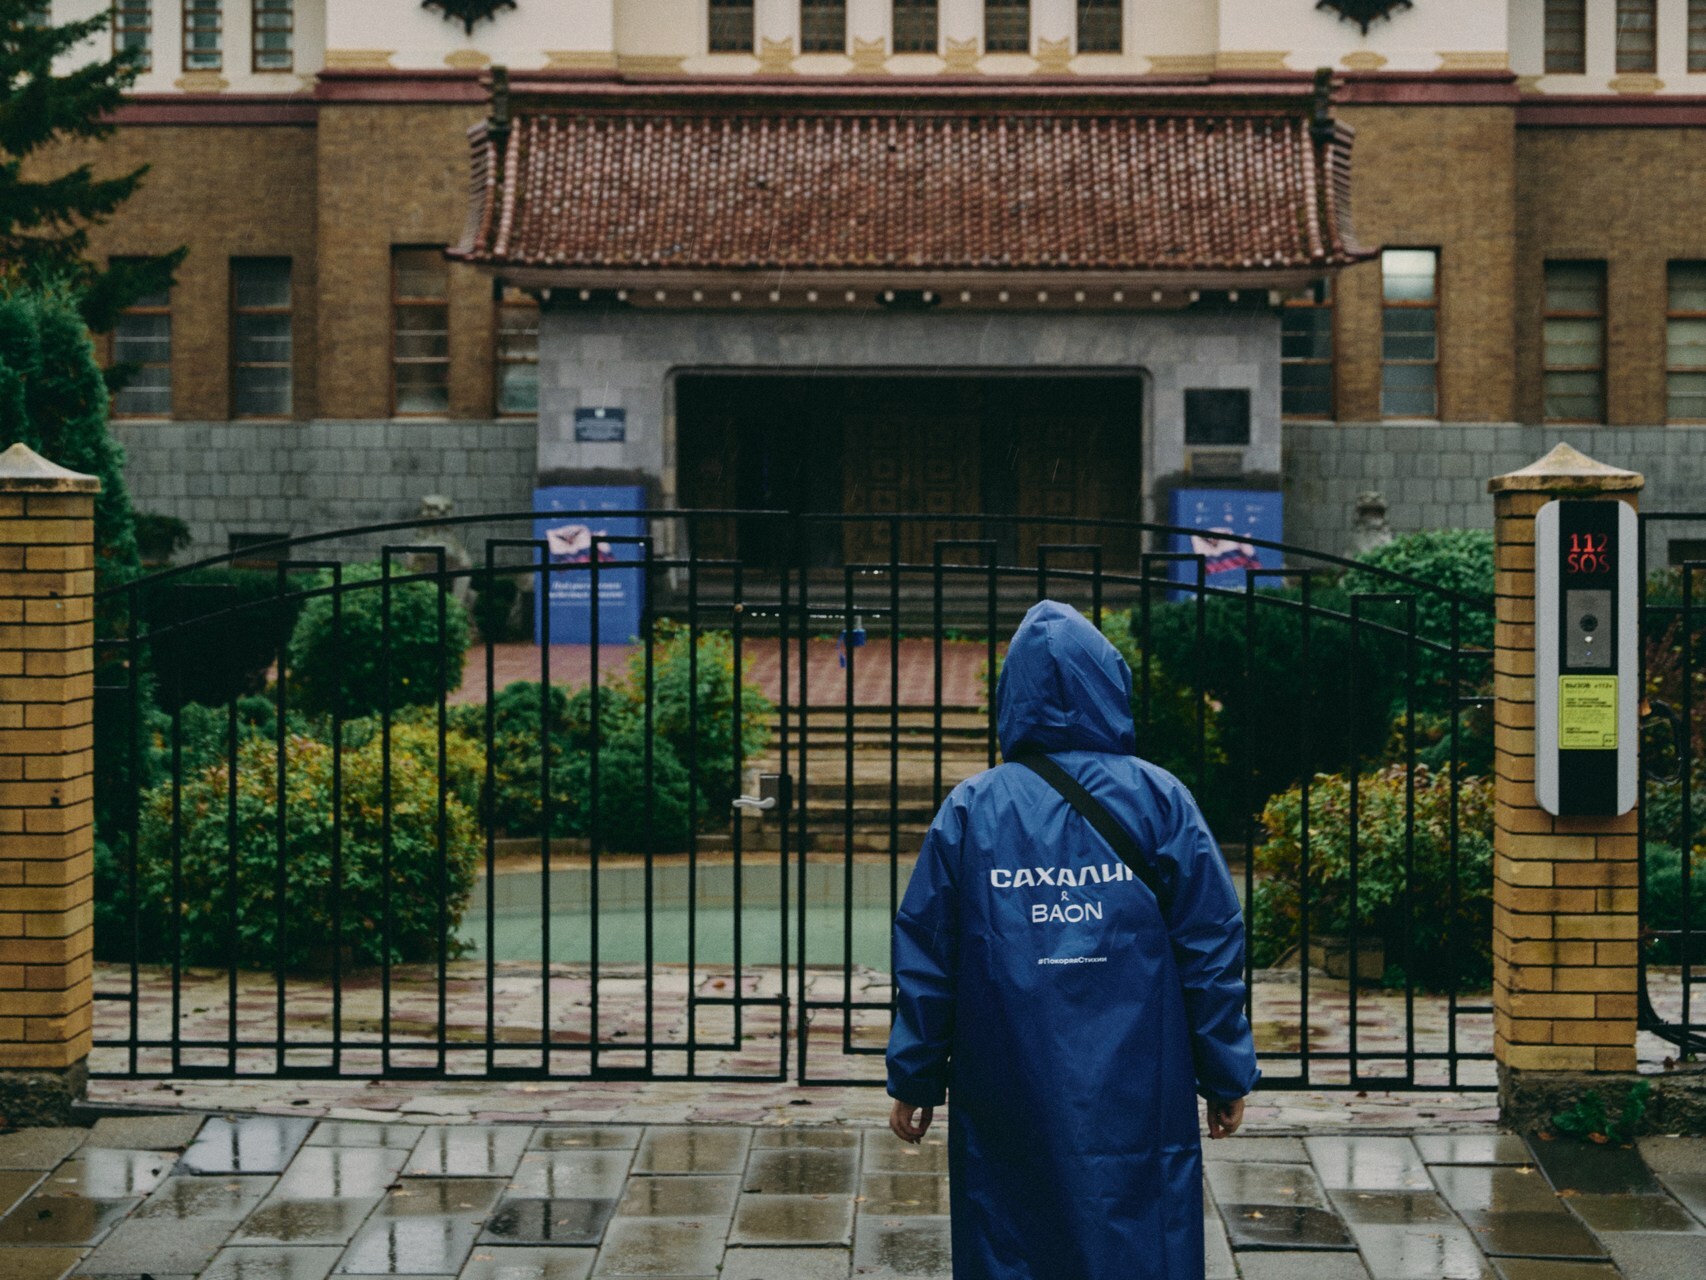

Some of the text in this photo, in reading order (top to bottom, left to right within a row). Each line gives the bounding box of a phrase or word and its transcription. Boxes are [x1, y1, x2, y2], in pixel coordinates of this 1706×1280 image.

[1570, 533, 1608, 552] 112
[1567, 553, 1610, 574] SOS
[1061, 890, 1070, 902] &
[1031, 902, 1103, 923] BAON
